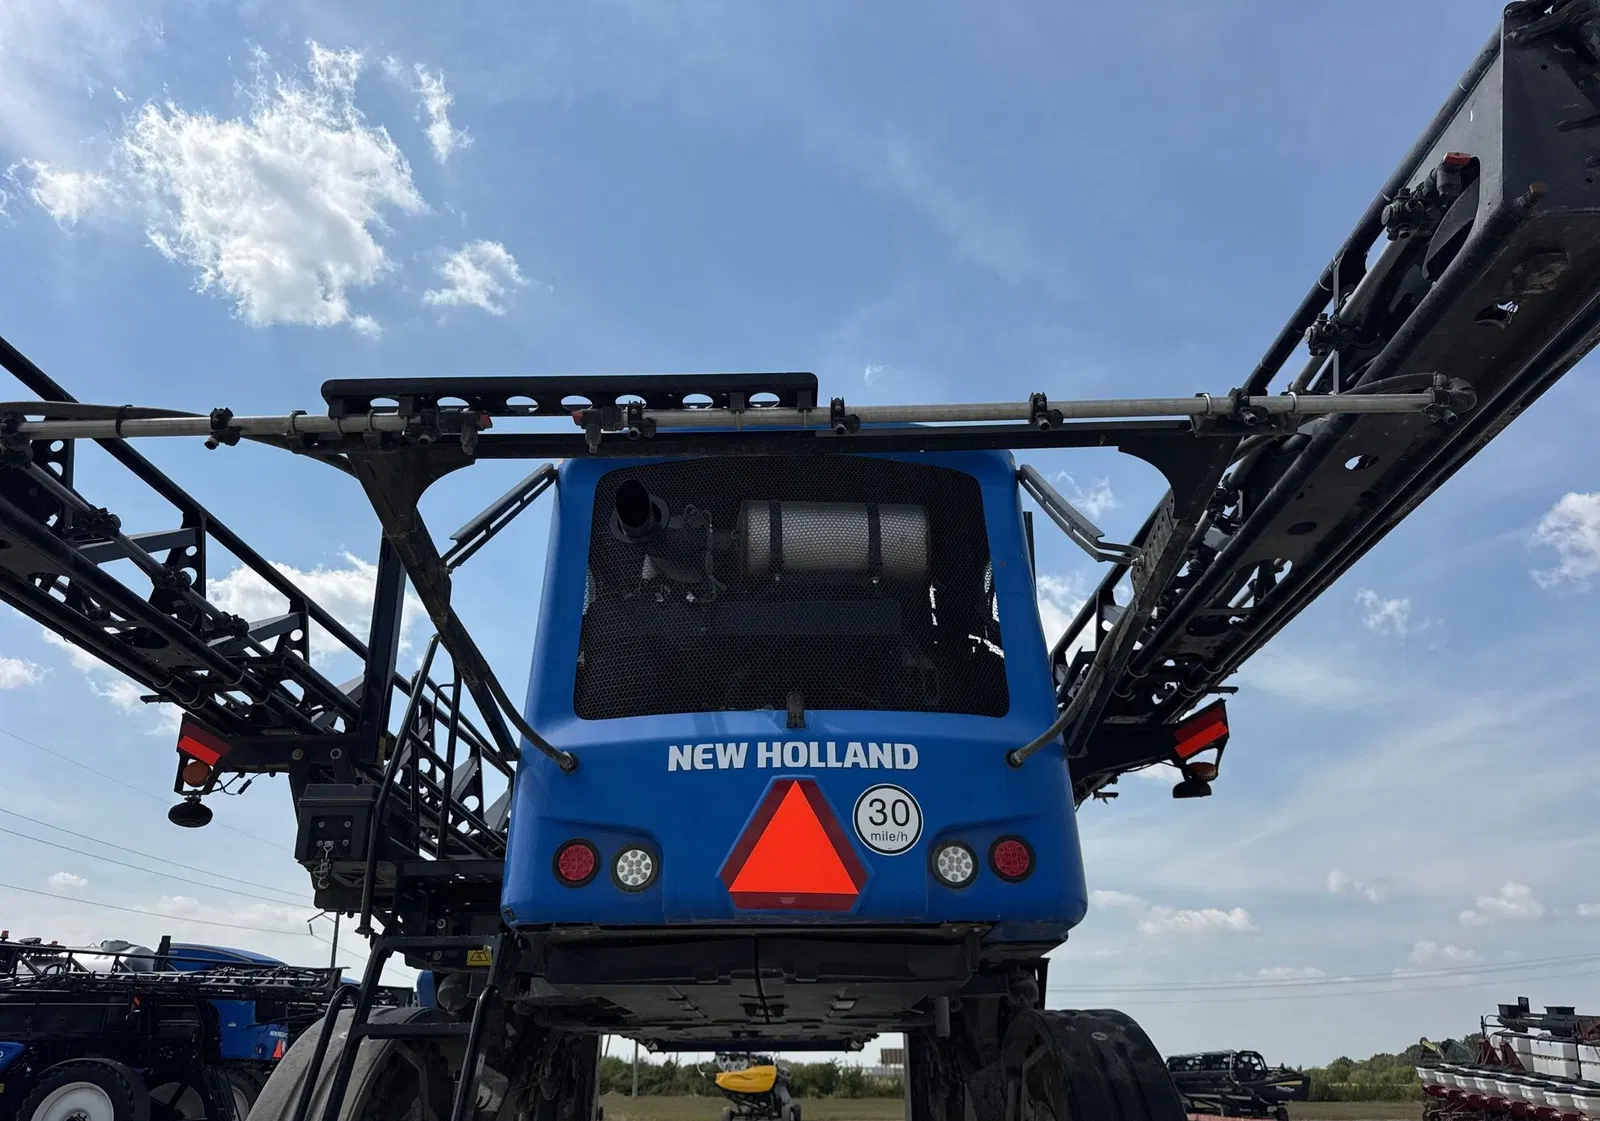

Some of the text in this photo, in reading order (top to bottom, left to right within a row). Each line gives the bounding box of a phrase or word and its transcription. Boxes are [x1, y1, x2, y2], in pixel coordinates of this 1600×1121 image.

[668, 741, 919, 771] NEW HOLLAND
[869, 798, 910, 827] 30
[870, 831, 908, 842] mile/h
